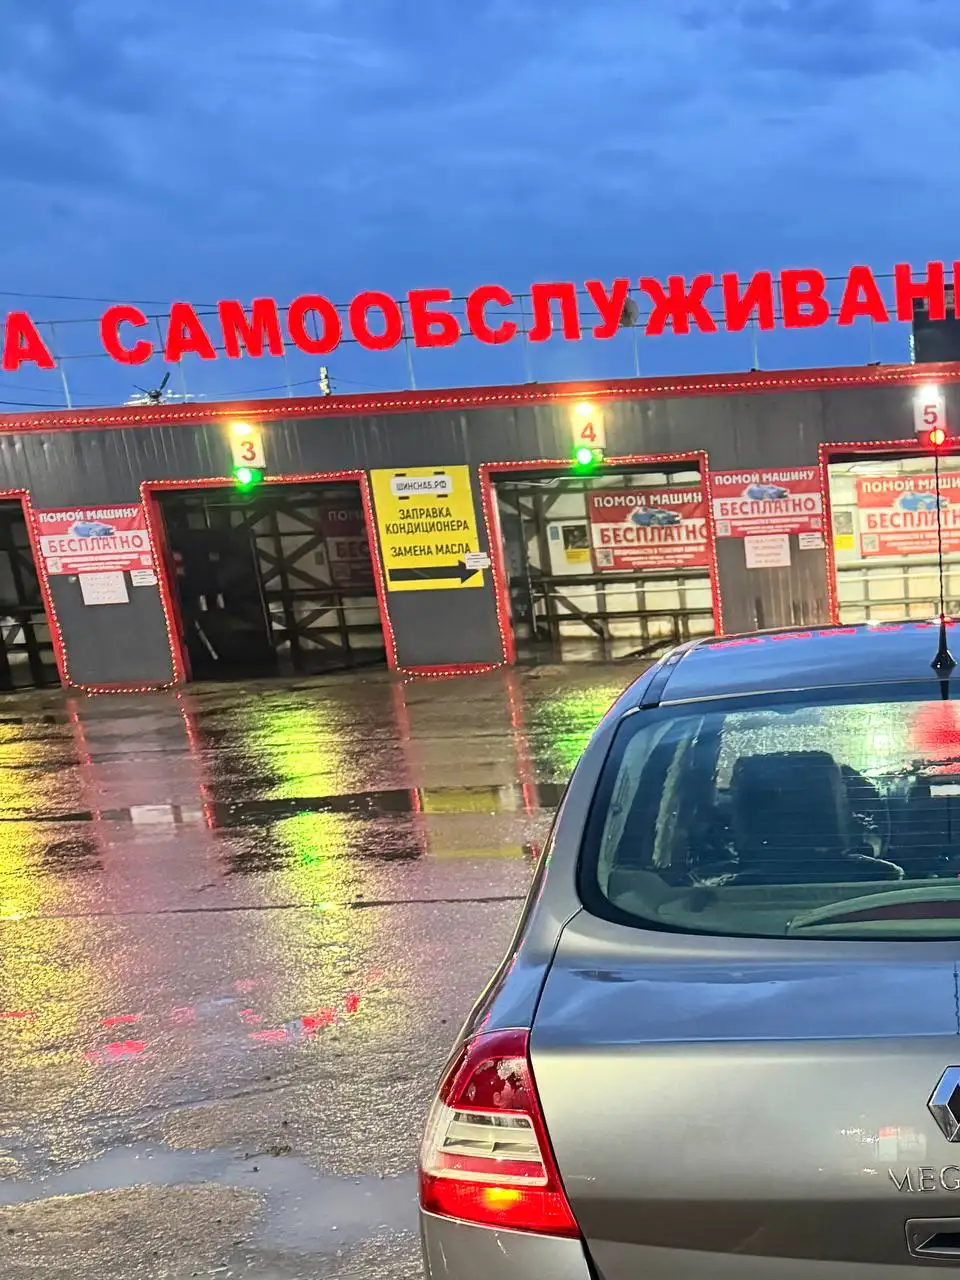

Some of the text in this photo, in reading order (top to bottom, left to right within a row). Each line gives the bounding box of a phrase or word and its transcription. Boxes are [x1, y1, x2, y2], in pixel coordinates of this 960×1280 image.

[922, 404, 938, 425] 5
[579, 422, 597, 442] 4
[240, 440, 257, 462] 3
[715, 470, 814, 485] ПОМОЙ МАШИНУ
[862, 478, 914, 493] ПОМОЙ
[594, 492, 703, 508] ПОМОЙ МАШИН
[719, 497, 816, 516] БЕСПЛАТНО
[38, 507, 139, 523] ПОМОЙ МАШИНУ
[398, 507, 452, 520] ЗАПРАВКА
[385, 520, 470, 535] КОНДИЦИОНЕРА
[47, 534, 144, 553] БЕСПЛАТНО
[390, 543, 471, 557] ЗАМЕНА МАСЛА
